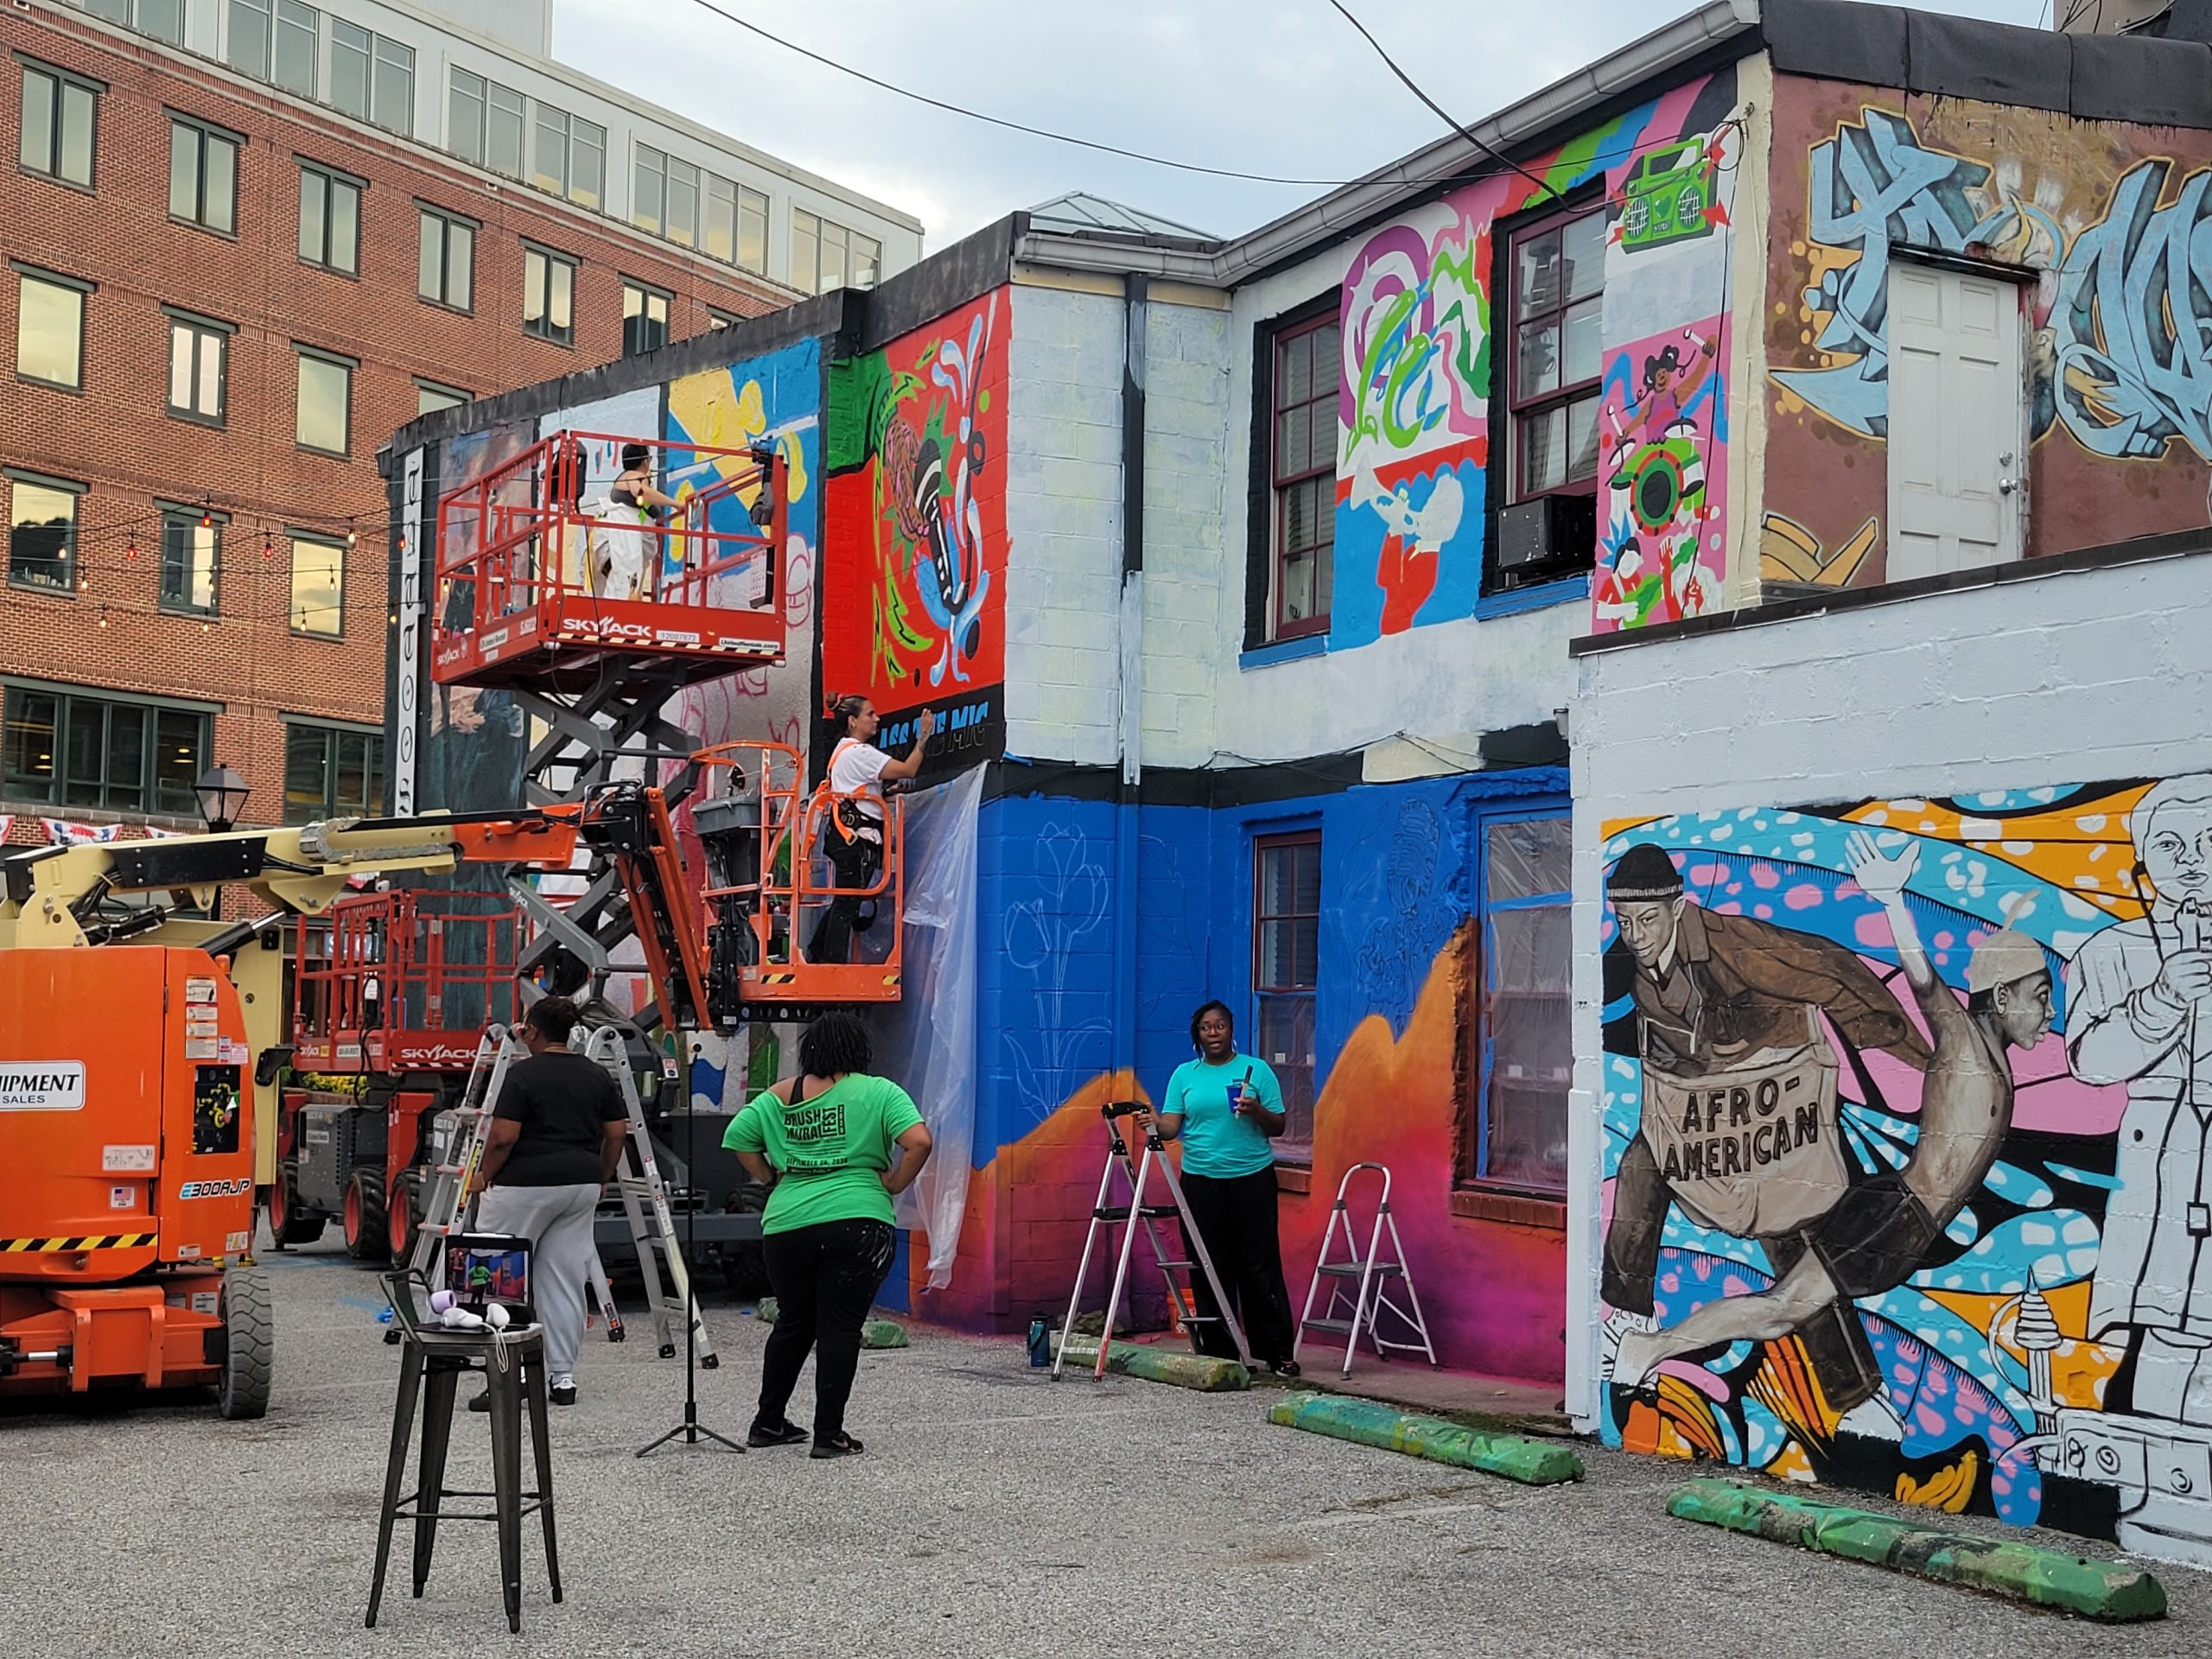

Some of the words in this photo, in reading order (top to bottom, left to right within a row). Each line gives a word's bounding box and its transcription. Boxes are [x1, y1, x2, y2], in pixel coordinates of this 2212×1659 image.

[563, 615, 652, 637] SKYJACK
[912, 710, 947, 741] TE
[950, 700, 989, 731] MIC
[0, 1074, 80, 1092] IPMENT
[2, 1095, 46, 1104] SALES
[1681, 1076, 1801, 1135] AFRO-
[784, 1109, 822, 1126] BRUSH
[822, 1107, 837, 1134] FEST
[785, 1123, 836, 1141] MURAL
[1662, 1102, 1819, 1183] AMERICAN
[181, 1179, 251, 1198] E300AJP
